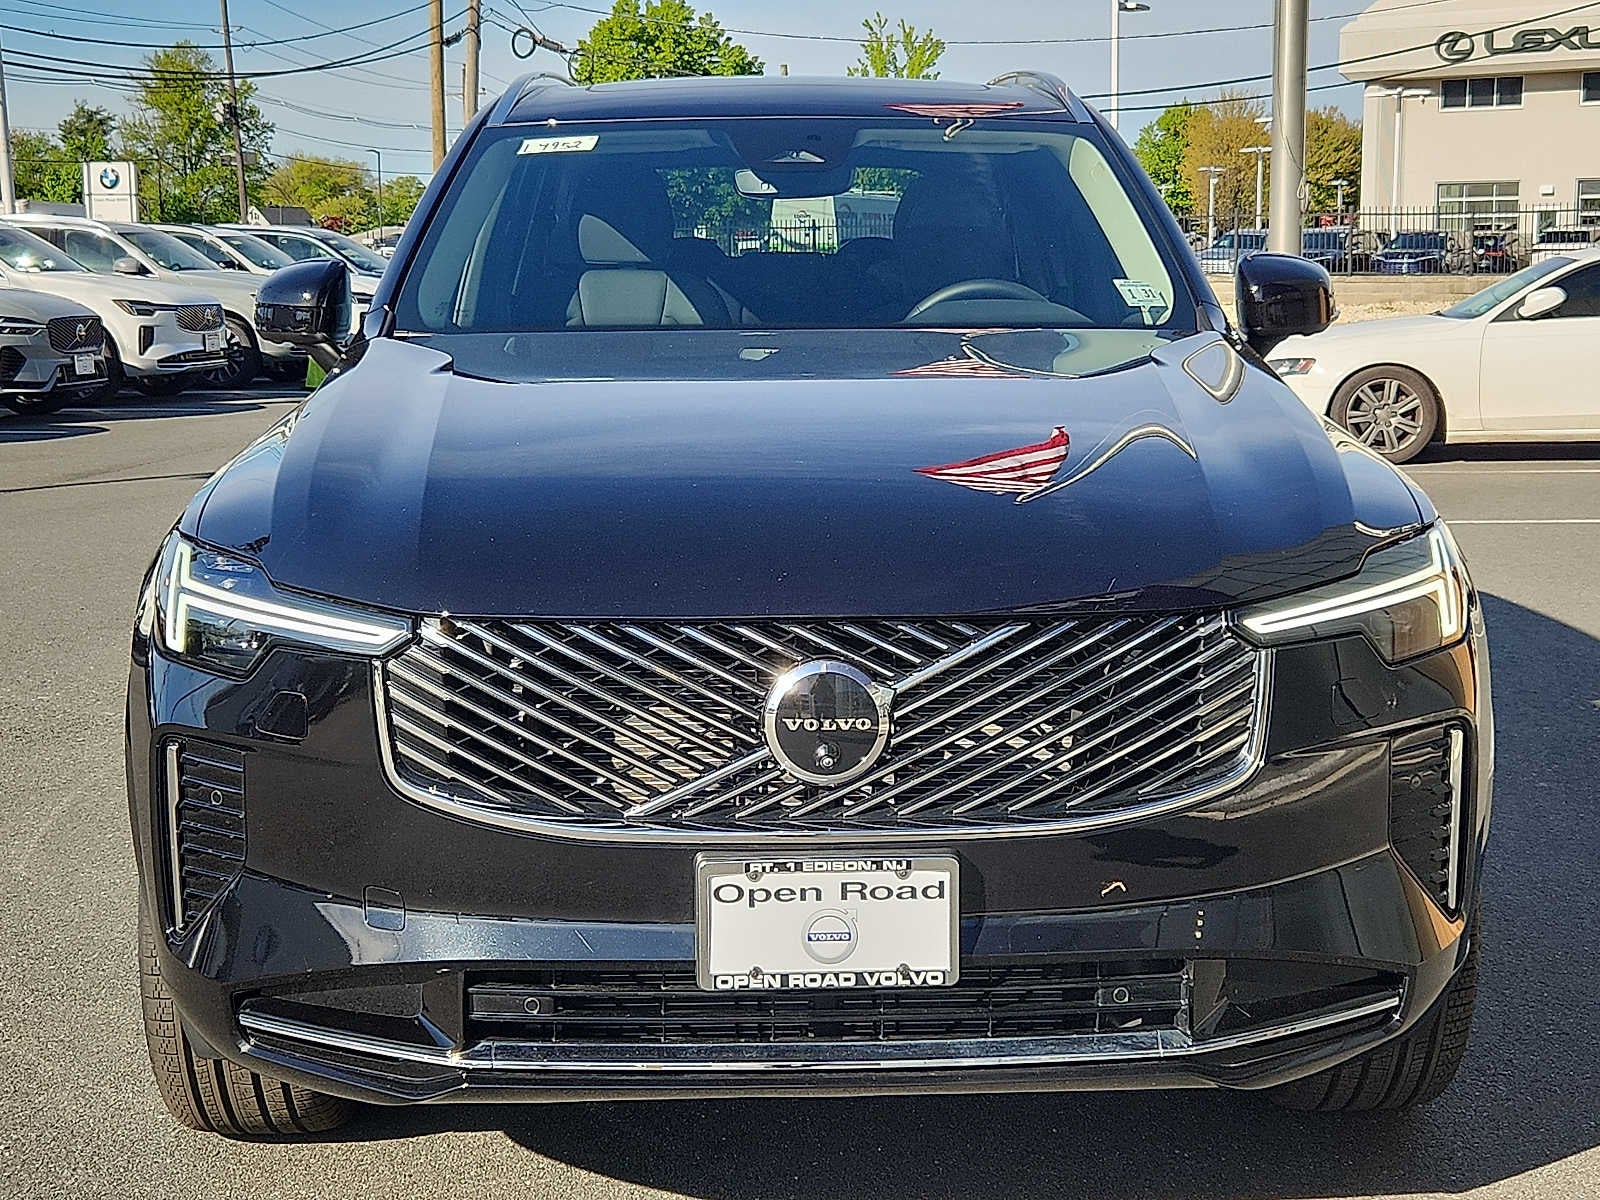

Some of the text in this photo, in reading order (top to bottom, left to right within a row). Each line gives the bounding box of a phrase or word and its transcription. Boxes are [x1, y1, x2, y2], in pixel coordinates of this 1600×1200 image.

[782, 718, 872, 731] VOLVO
[786, 862, 795, 872] 1
[802, 860, 877, 872] EDISON,
[883, 860, 907, 871] NJ
[713, 880, 945, 908] Open Road
[809, 932, 850, 941] VOLVO
[716, 971, 944, 989] OPEN ROAD VOLVO
